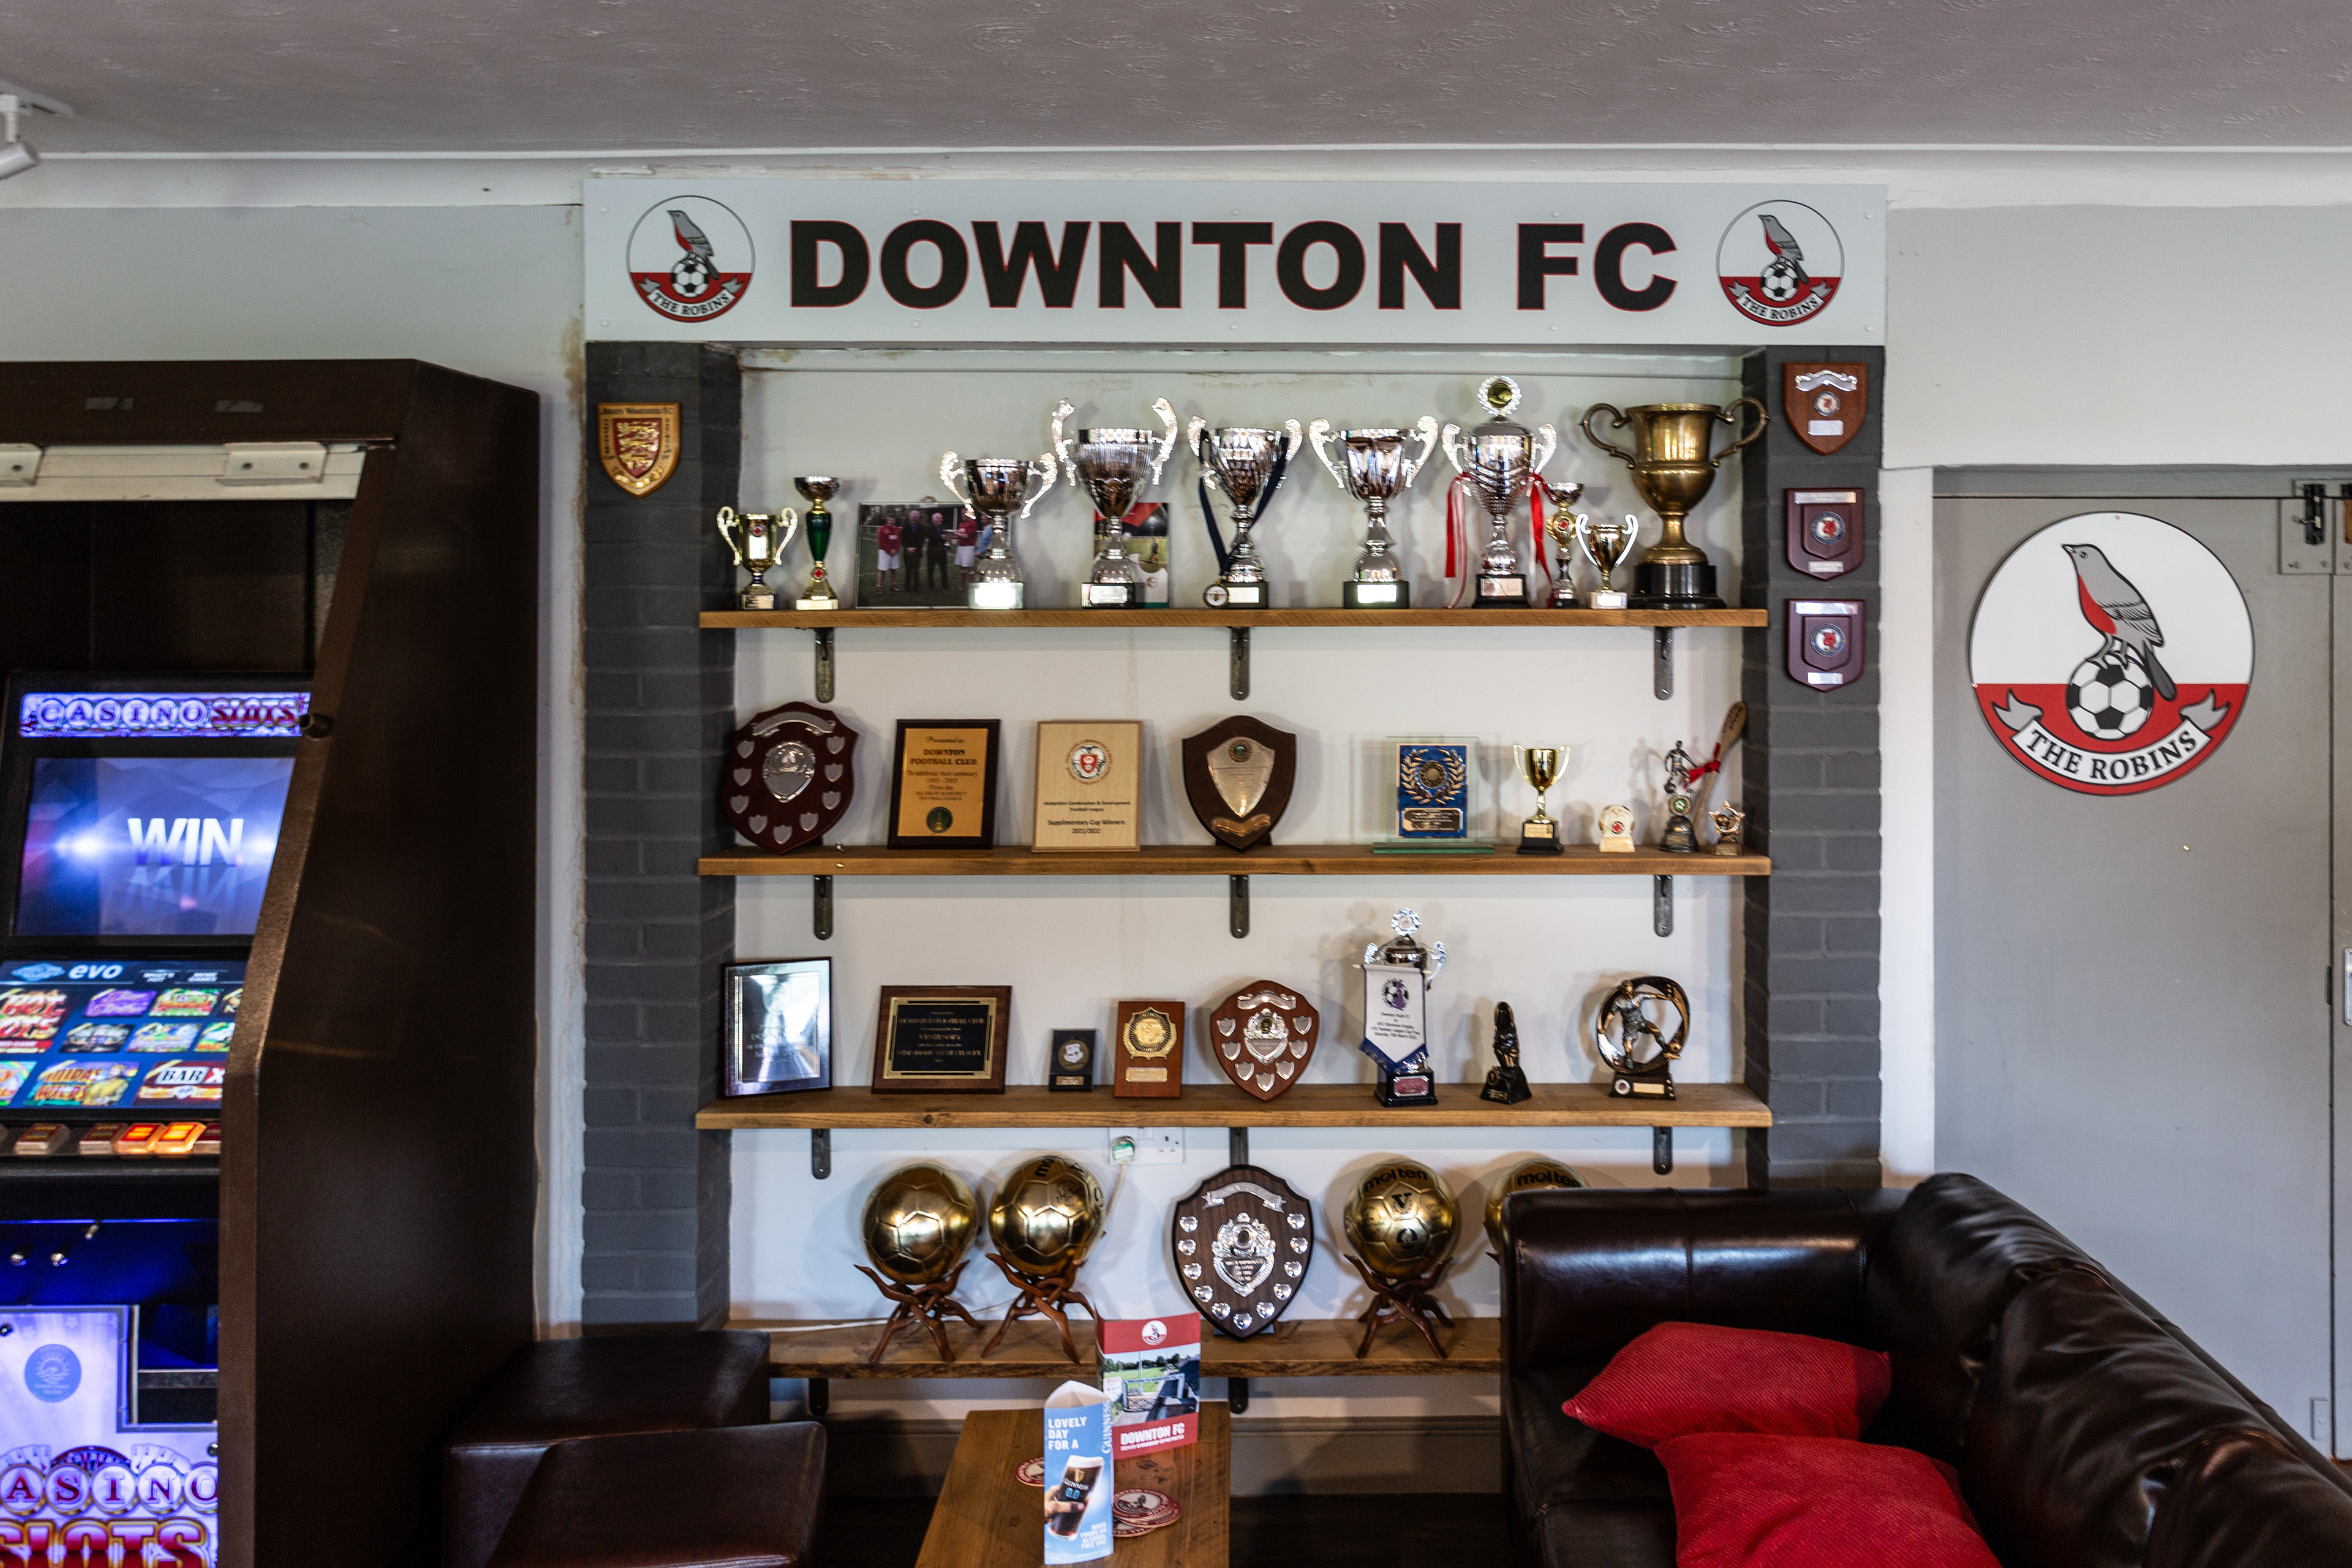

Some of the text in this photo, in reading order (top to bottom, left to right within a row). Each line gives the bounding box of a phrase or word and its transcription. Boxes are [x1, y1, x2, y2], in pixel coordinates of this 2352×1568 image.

[790, 219, 1678, 311] DOWNTON FC
[653, 292, 731, 315] THE ROBINS
[1741, 296, 1819, 320] THE ROBINS
[39, 697, 296, 728] CASINO SLOTS
[2024, 728, 2198, 782] THE ROBINS
[127, 817, 244, 866] WIN
[68, 963, 123, 979] evo
[161, 1068, 205, 1084] BAR
[1363, 1167, 1428, 1193] molten
[1517, 1170, 1581, 1188] molten
[1048, 1415, 1088, 1429] LOVELY
[1101, 1399, 1112, 1454] GUINNESS
[1048, 1429, 1069, 1440] DAY
[1048, 1439, 1079, 1450] FOR A
[1120, 1422, 1186, 1446] DOWNTON FC
[1063, 1477, 1090, 1491] GUINNESS
[1065, 1487, 1081, 1500] 0.0
